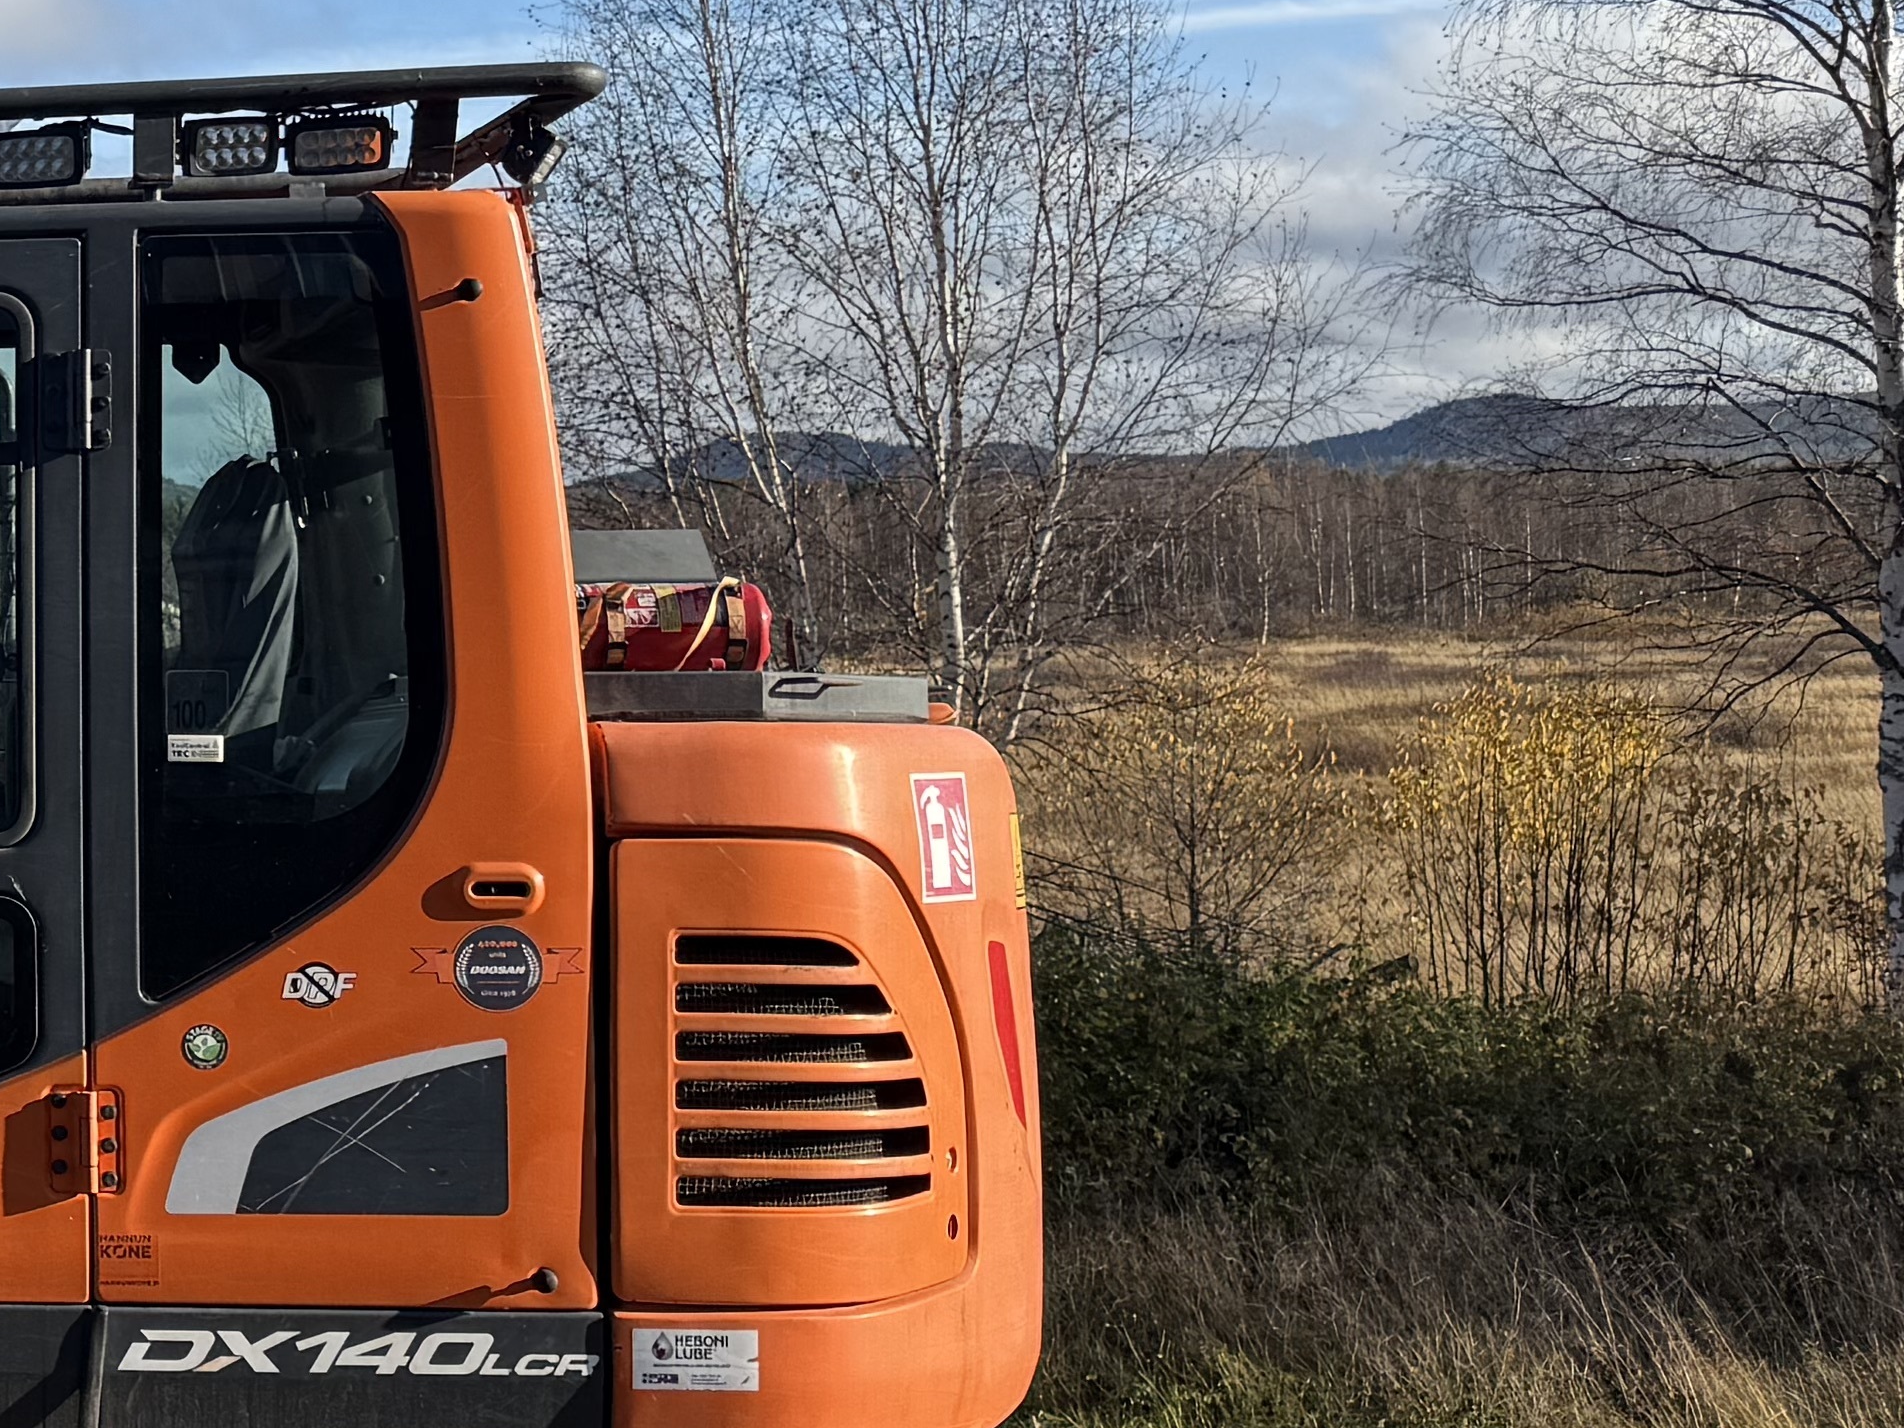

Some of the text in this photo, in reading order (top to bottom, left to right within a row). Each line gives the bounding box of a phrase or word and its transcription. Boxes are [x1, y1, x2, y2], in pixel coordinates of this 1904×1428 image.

[470, 965, 526, 975] DOOSAN
[100, 1244, 152, 1259] KONE
[675, 1335, 729, 1348] HEBONI
[675, 1348, 714, 1360] LUBE
